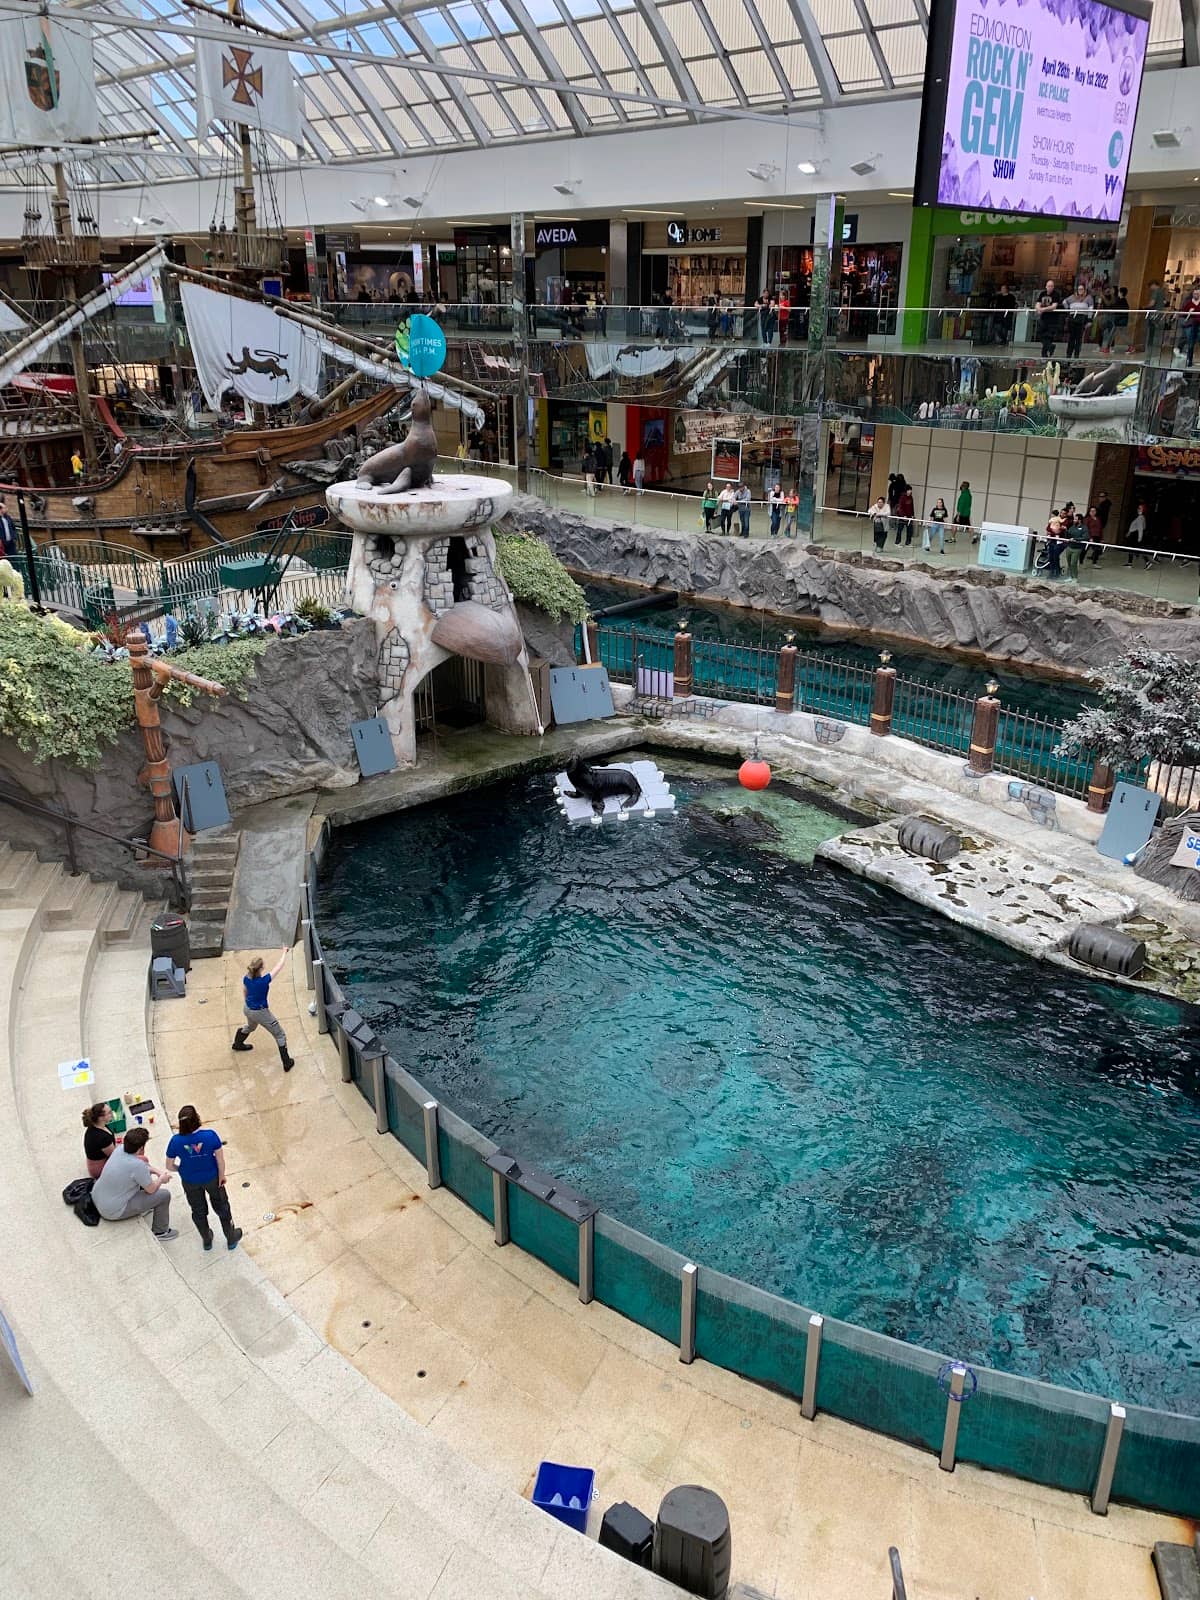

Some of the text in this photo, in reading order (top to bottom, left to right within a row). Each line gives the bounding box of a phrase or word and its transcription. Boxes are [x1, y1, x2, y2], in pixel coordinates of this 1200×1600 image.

[970, 13, 1032, 50] EDMONTON
[966, 36, 1016, 87] ROCK
[1042, 56, 1056, 77] April
[1075, 66, 1086, 87] May
[1095, 72, 1109, 89] 2022
[1039, 82, 1070, 103] ICE PALACE
[961, 79, 1025, 160] GEM
[1033, 135, 1075, 155] SHOW HOURS
[993, 159, 1016, 180] SHOW
[537, 228, 577, 243] AVEDA
[667, 222, 720, 243] QE HOME
